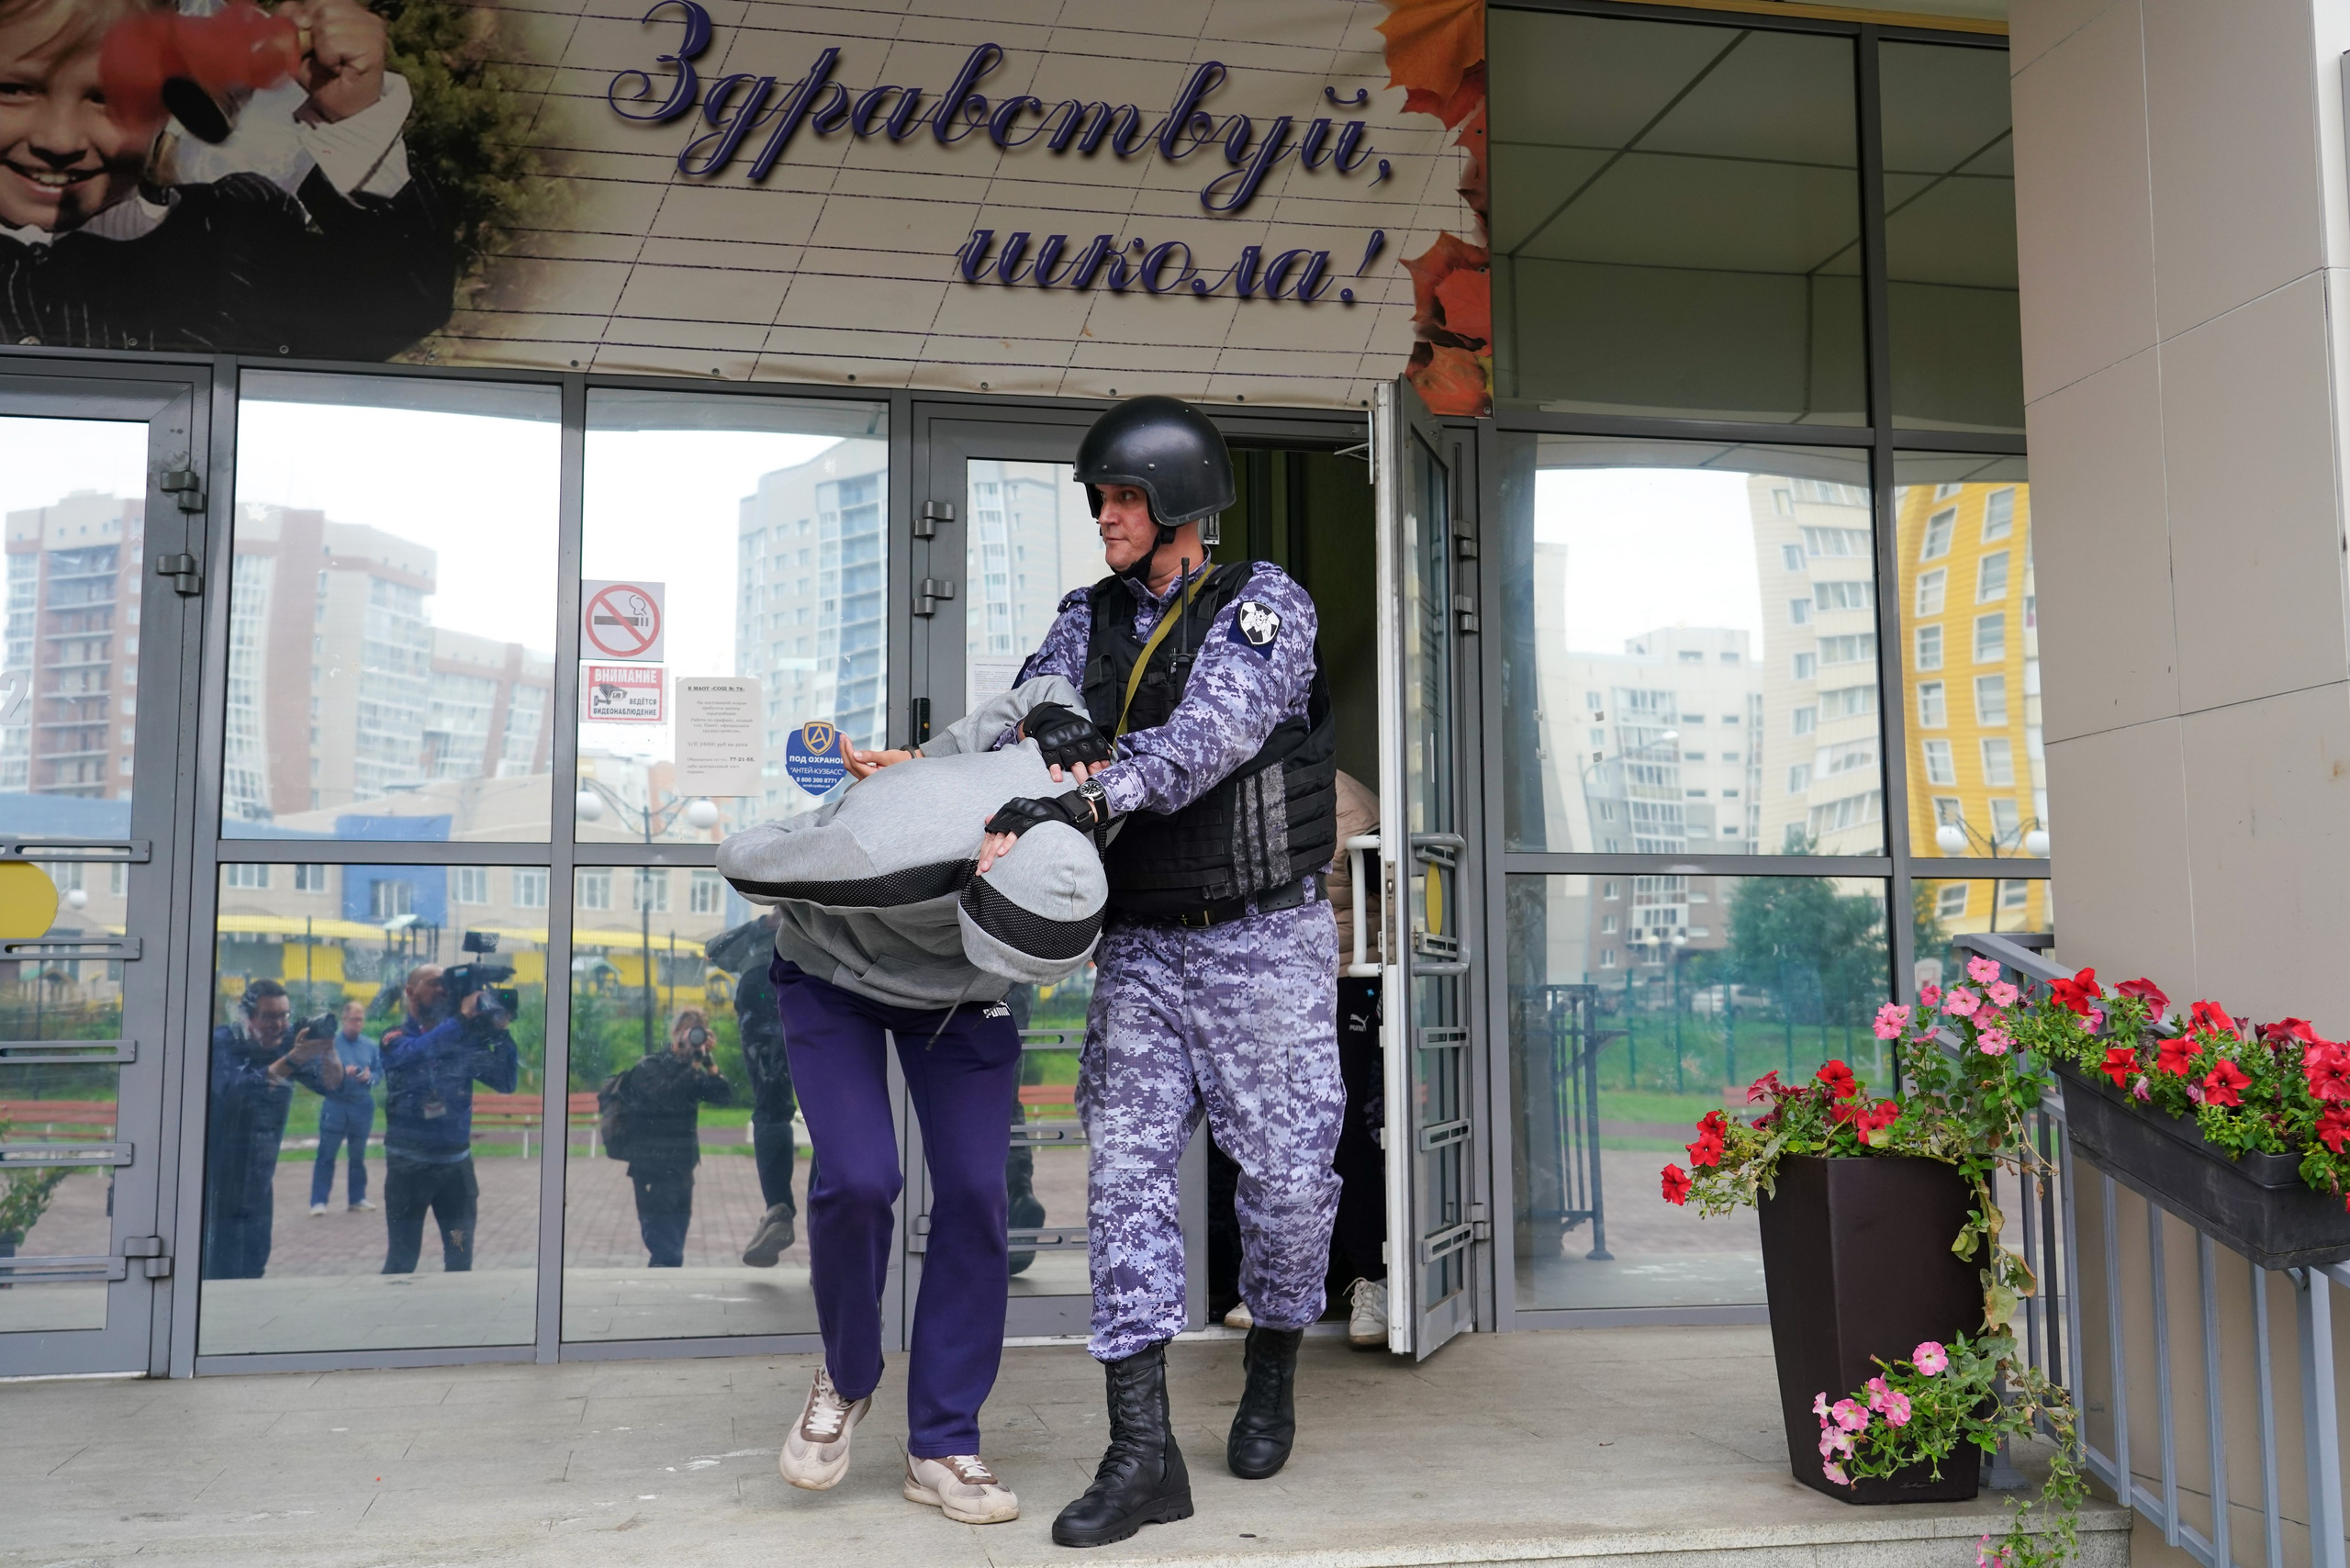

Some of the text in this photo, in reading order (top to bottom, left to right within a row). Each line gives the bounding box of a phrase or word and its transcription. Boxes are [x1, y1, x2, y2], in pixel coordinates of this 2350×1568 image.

[608, 0, 1392, 211] Здравствуй,
[954, 229, 1385, 302] школа!
[594, 667, 657, 684] ВНИМАНИЕ
[629, 698, 657, 706] ВЕДЁТСЯ
[593, 707, 657, 716] ВИДЕОНАБЛЮДЕНИЕ
[789, 756, 807, 764] ПОД
